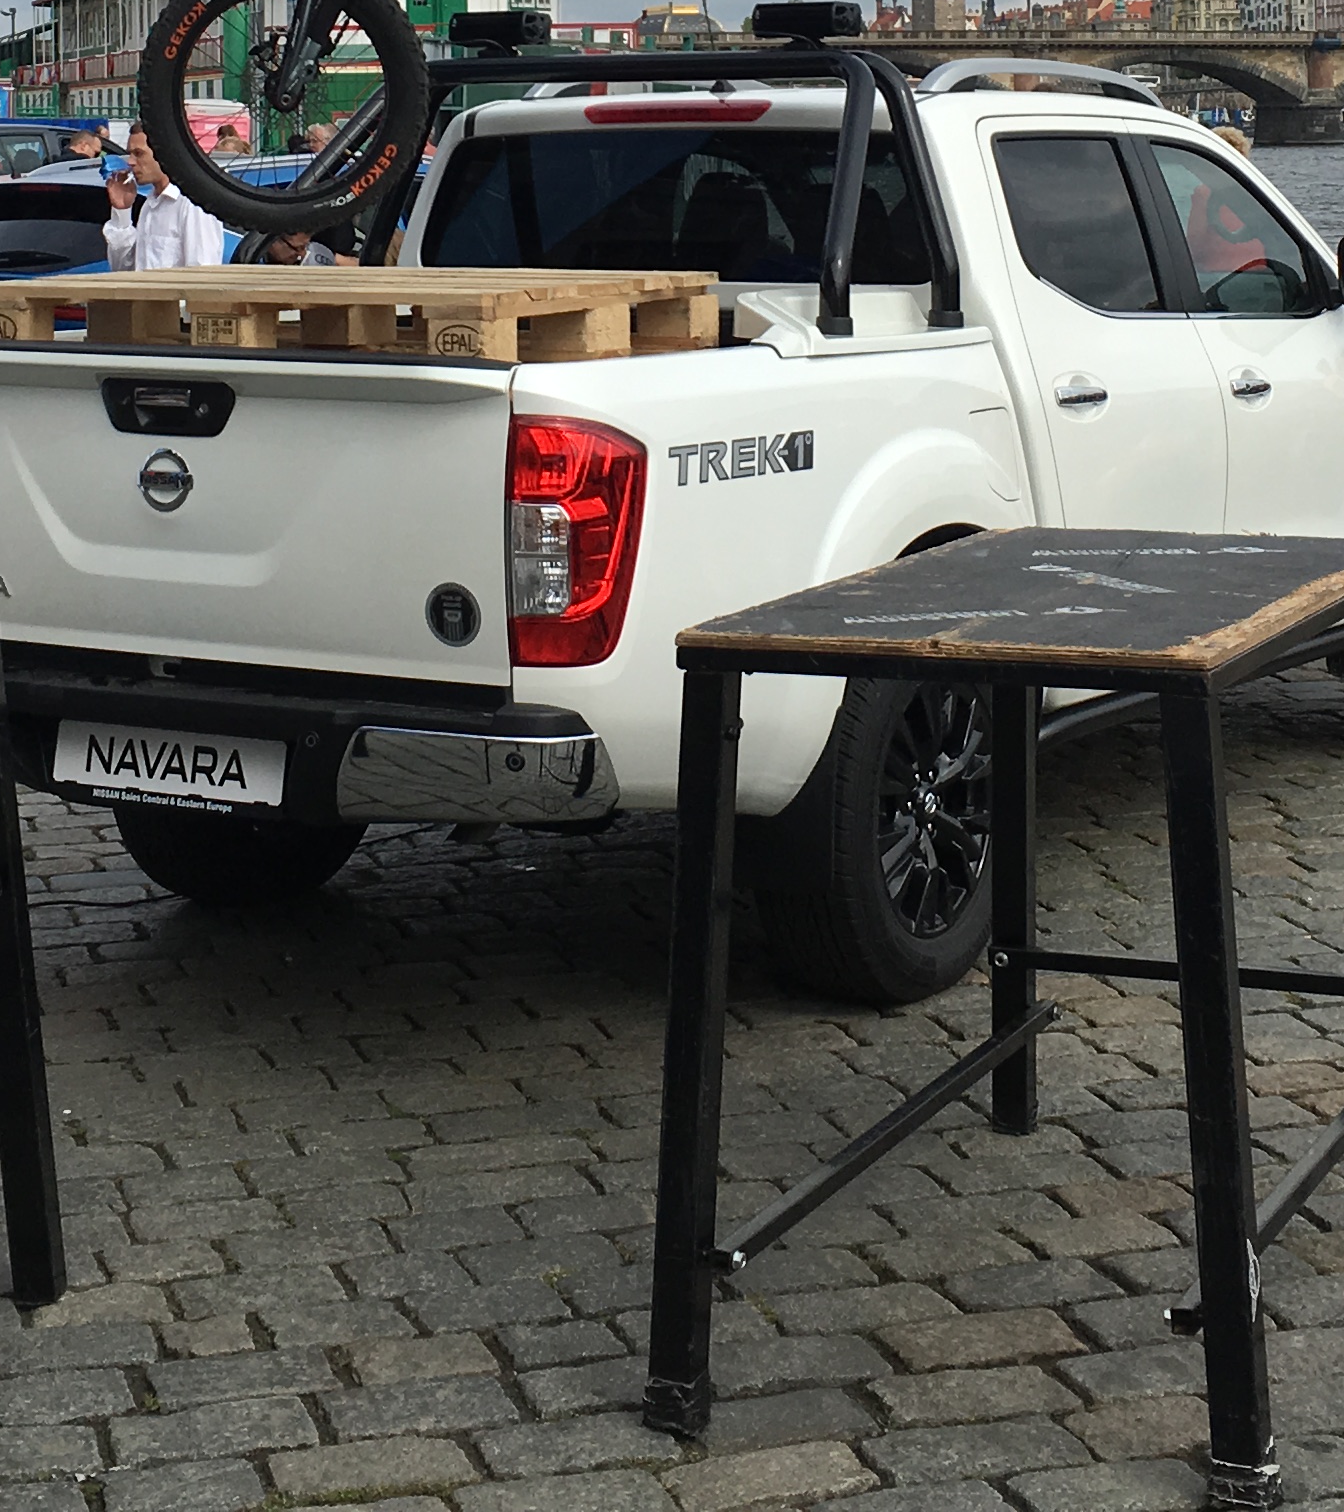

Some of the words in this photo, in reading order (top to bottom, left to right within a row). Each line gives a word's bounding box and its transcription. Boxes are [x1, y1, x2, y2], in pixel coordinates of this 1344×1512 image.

[442, 333, 476, 352] EPAL
[85, 733, 247, 790] NAVARA
[93, 789, 119, 800] NISSAN
[121, 791, 141, 802] Sales
[142, 794, 169, 805] Central
[177, 797, 205, 809] Eastern
[206, 801, 233, 814] Europe
